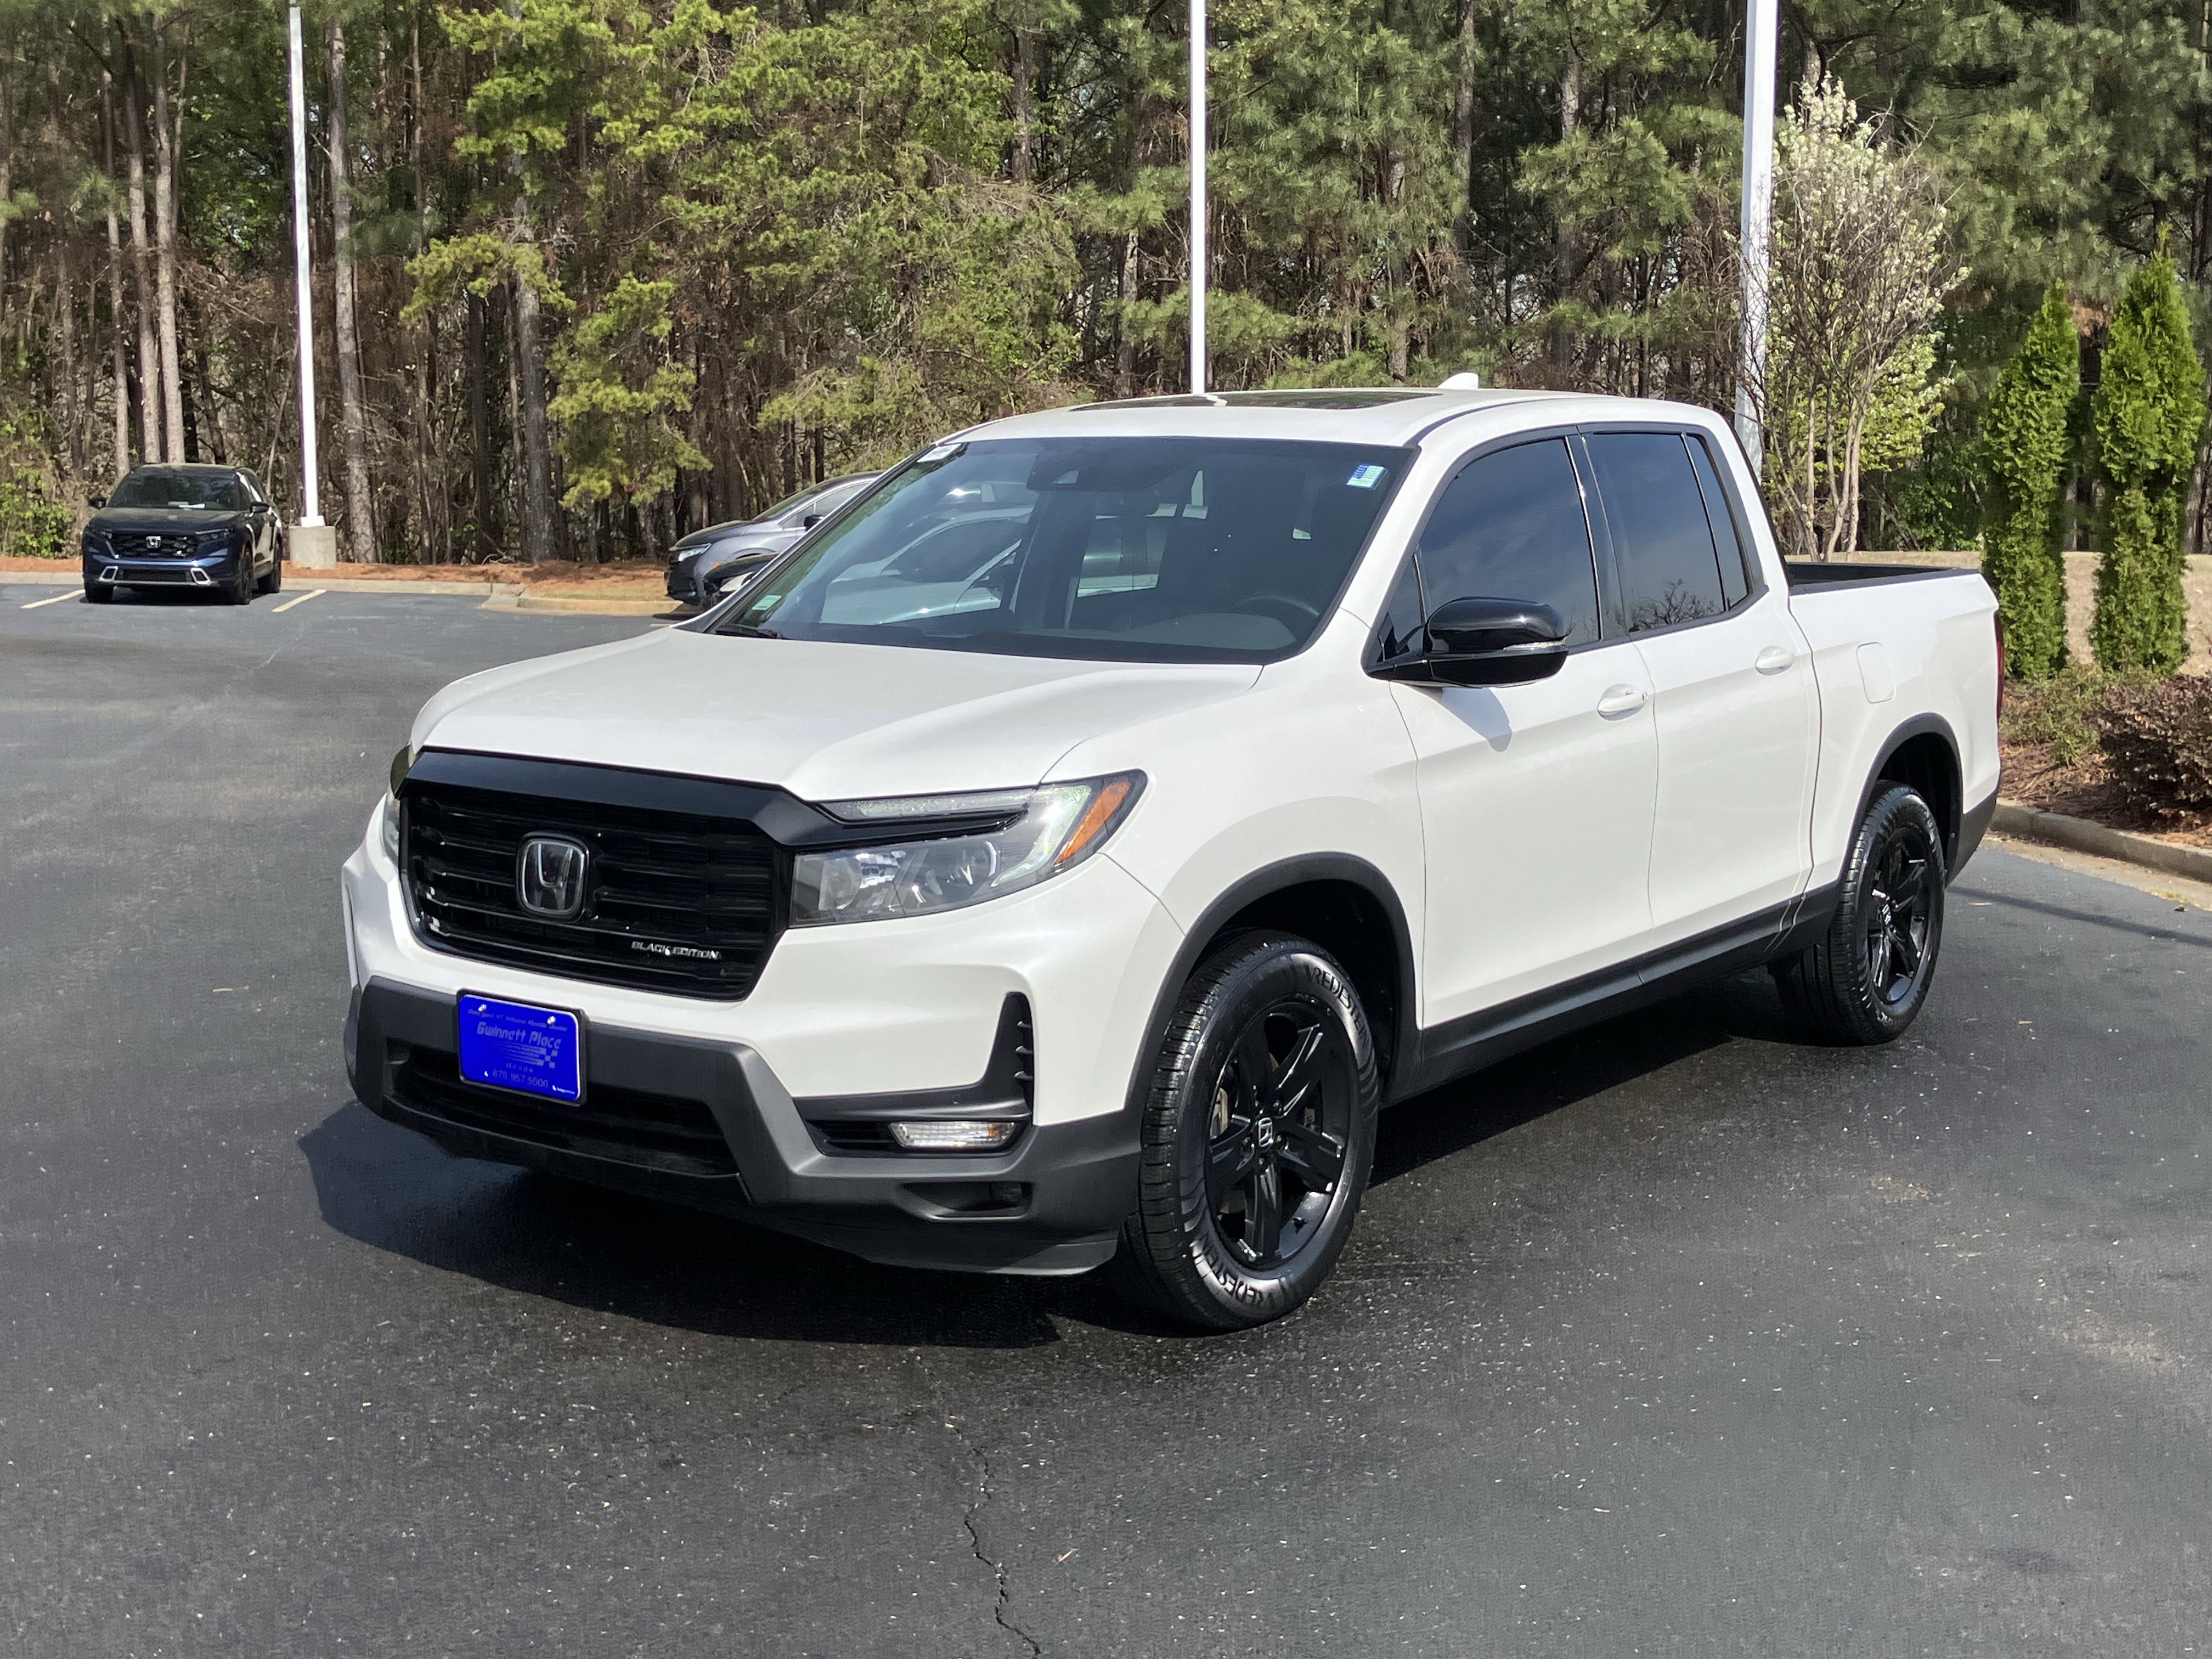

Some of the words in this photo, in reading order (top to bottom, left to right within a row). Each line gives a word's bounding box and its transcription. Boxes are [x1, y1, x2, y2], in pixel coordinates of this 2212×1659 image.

[631, 941, 670, 953] BLACK
[672, 946, 720, 960] EDITION
[477, 1022, 526, 1042] Gwinnett
[528, 1031, 562, 1049] Place
